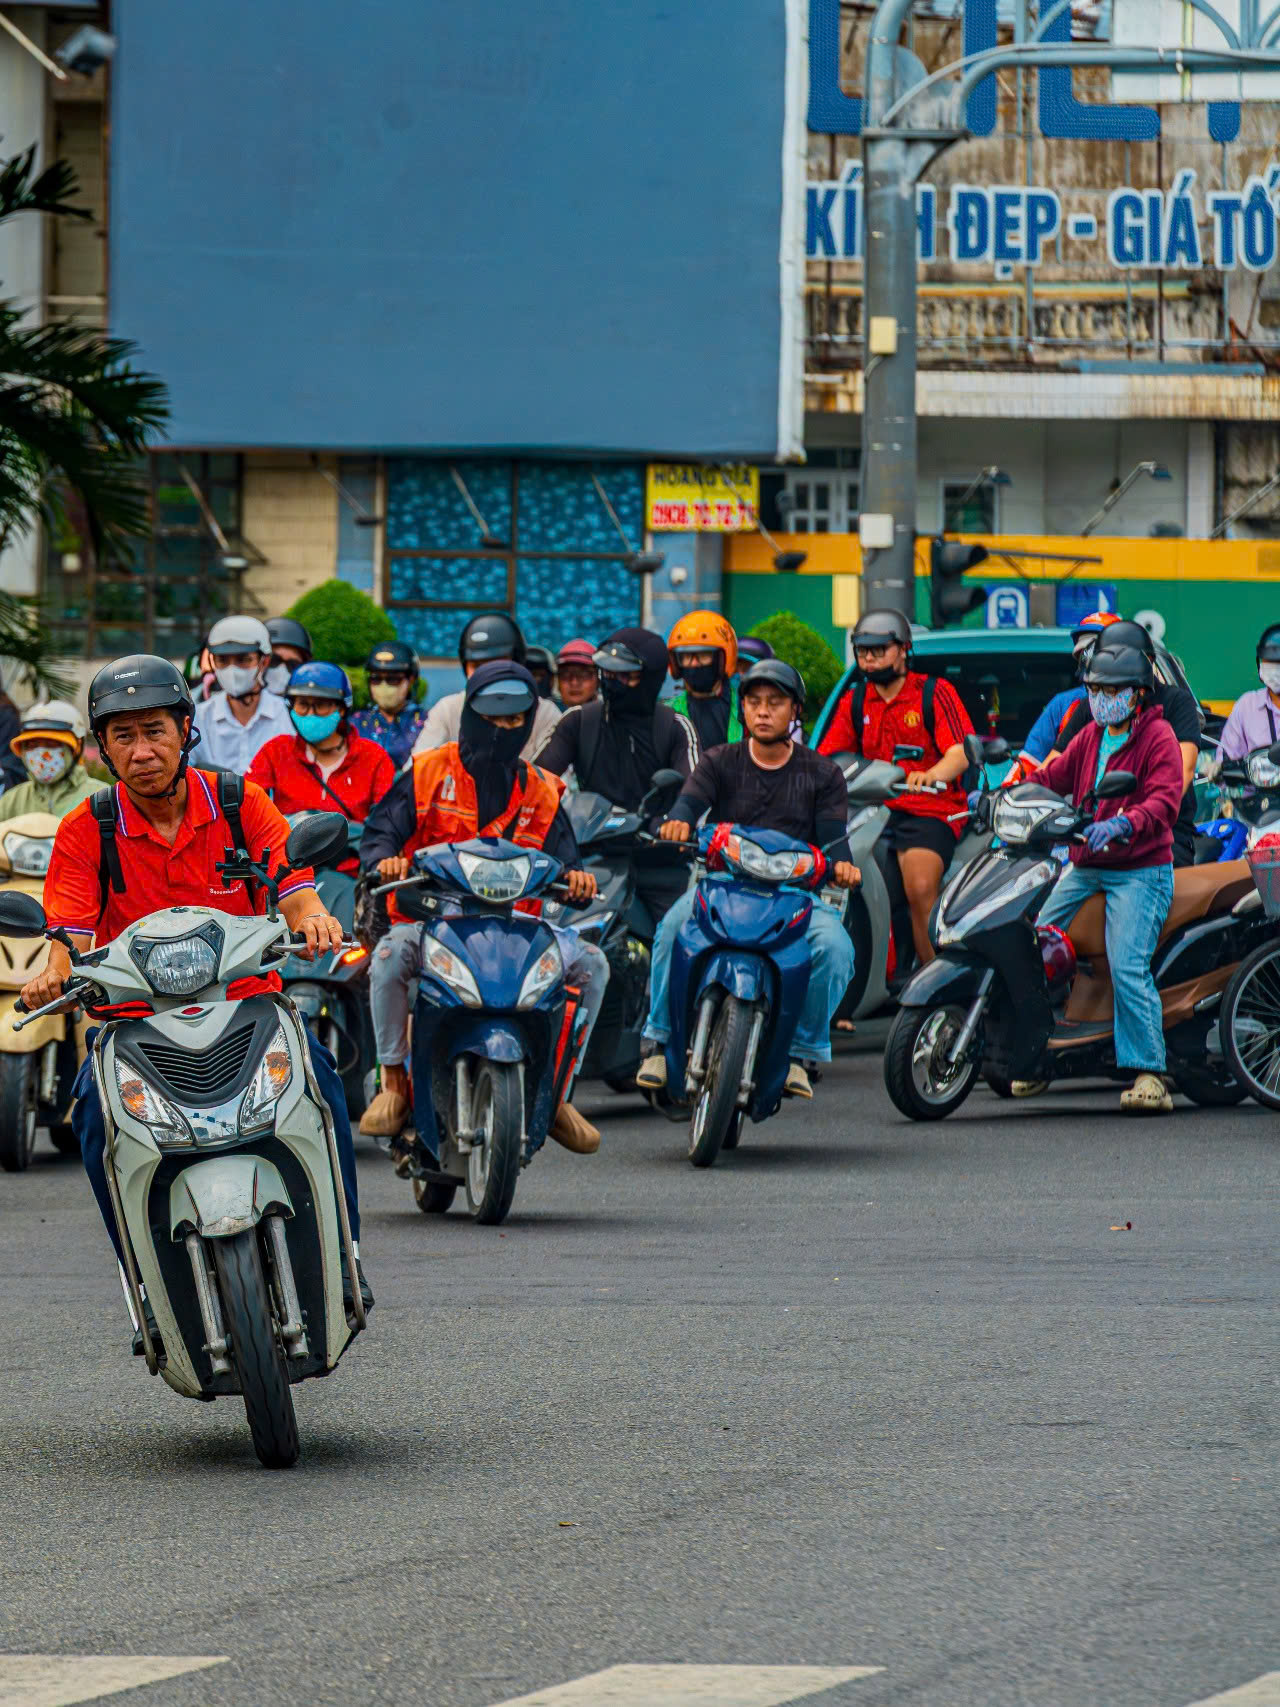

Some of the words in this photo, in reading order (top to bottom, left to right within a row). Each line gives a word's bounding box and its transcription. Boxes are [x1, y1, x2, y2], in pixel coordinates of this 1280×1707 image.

[806, 159, 937, 264] KÍH
[947, 183, 1062, 281] ĐẸP
[1107, 168, 1204, 270] GIÁ
